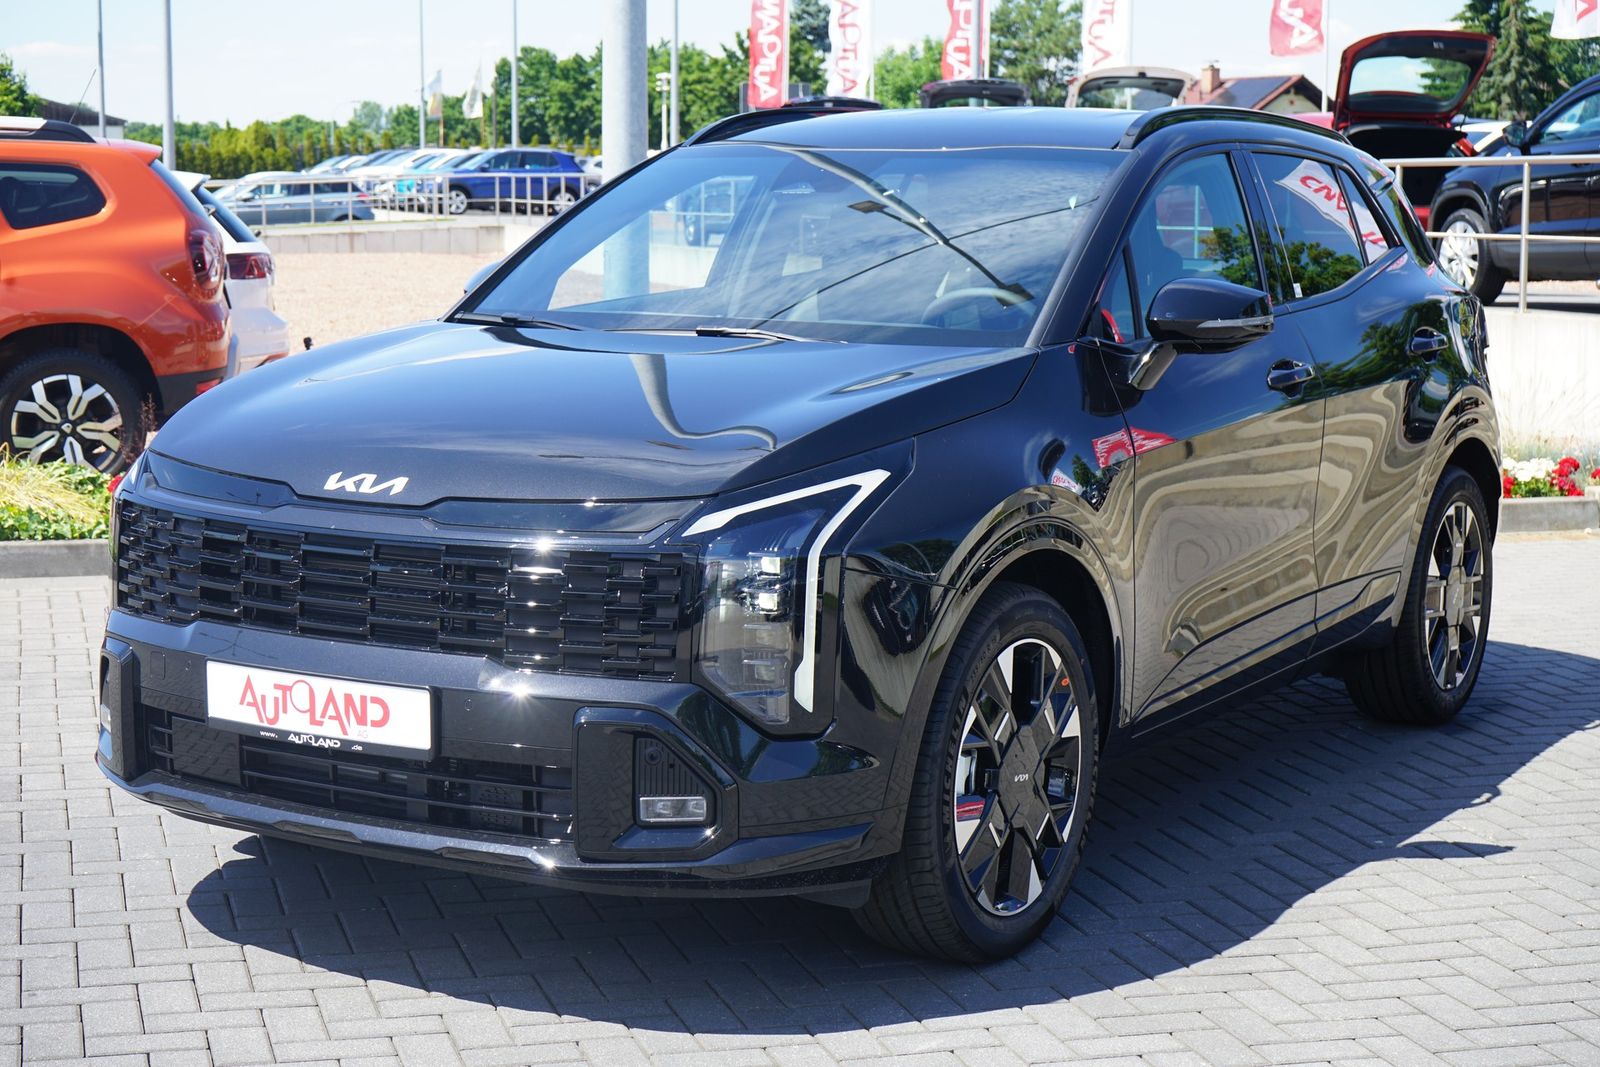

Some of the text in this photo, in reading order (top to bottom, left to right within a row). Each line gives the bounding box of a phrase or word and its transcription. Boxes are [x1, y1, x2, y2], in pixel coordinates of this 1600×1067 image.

[324, 471, 409, 496] KIA
[239, 674, 390, 736] AUTOLAND
[288, 733, 341, 748] AUTOLAND
[943, 688, 969, 826] MICHELIN
